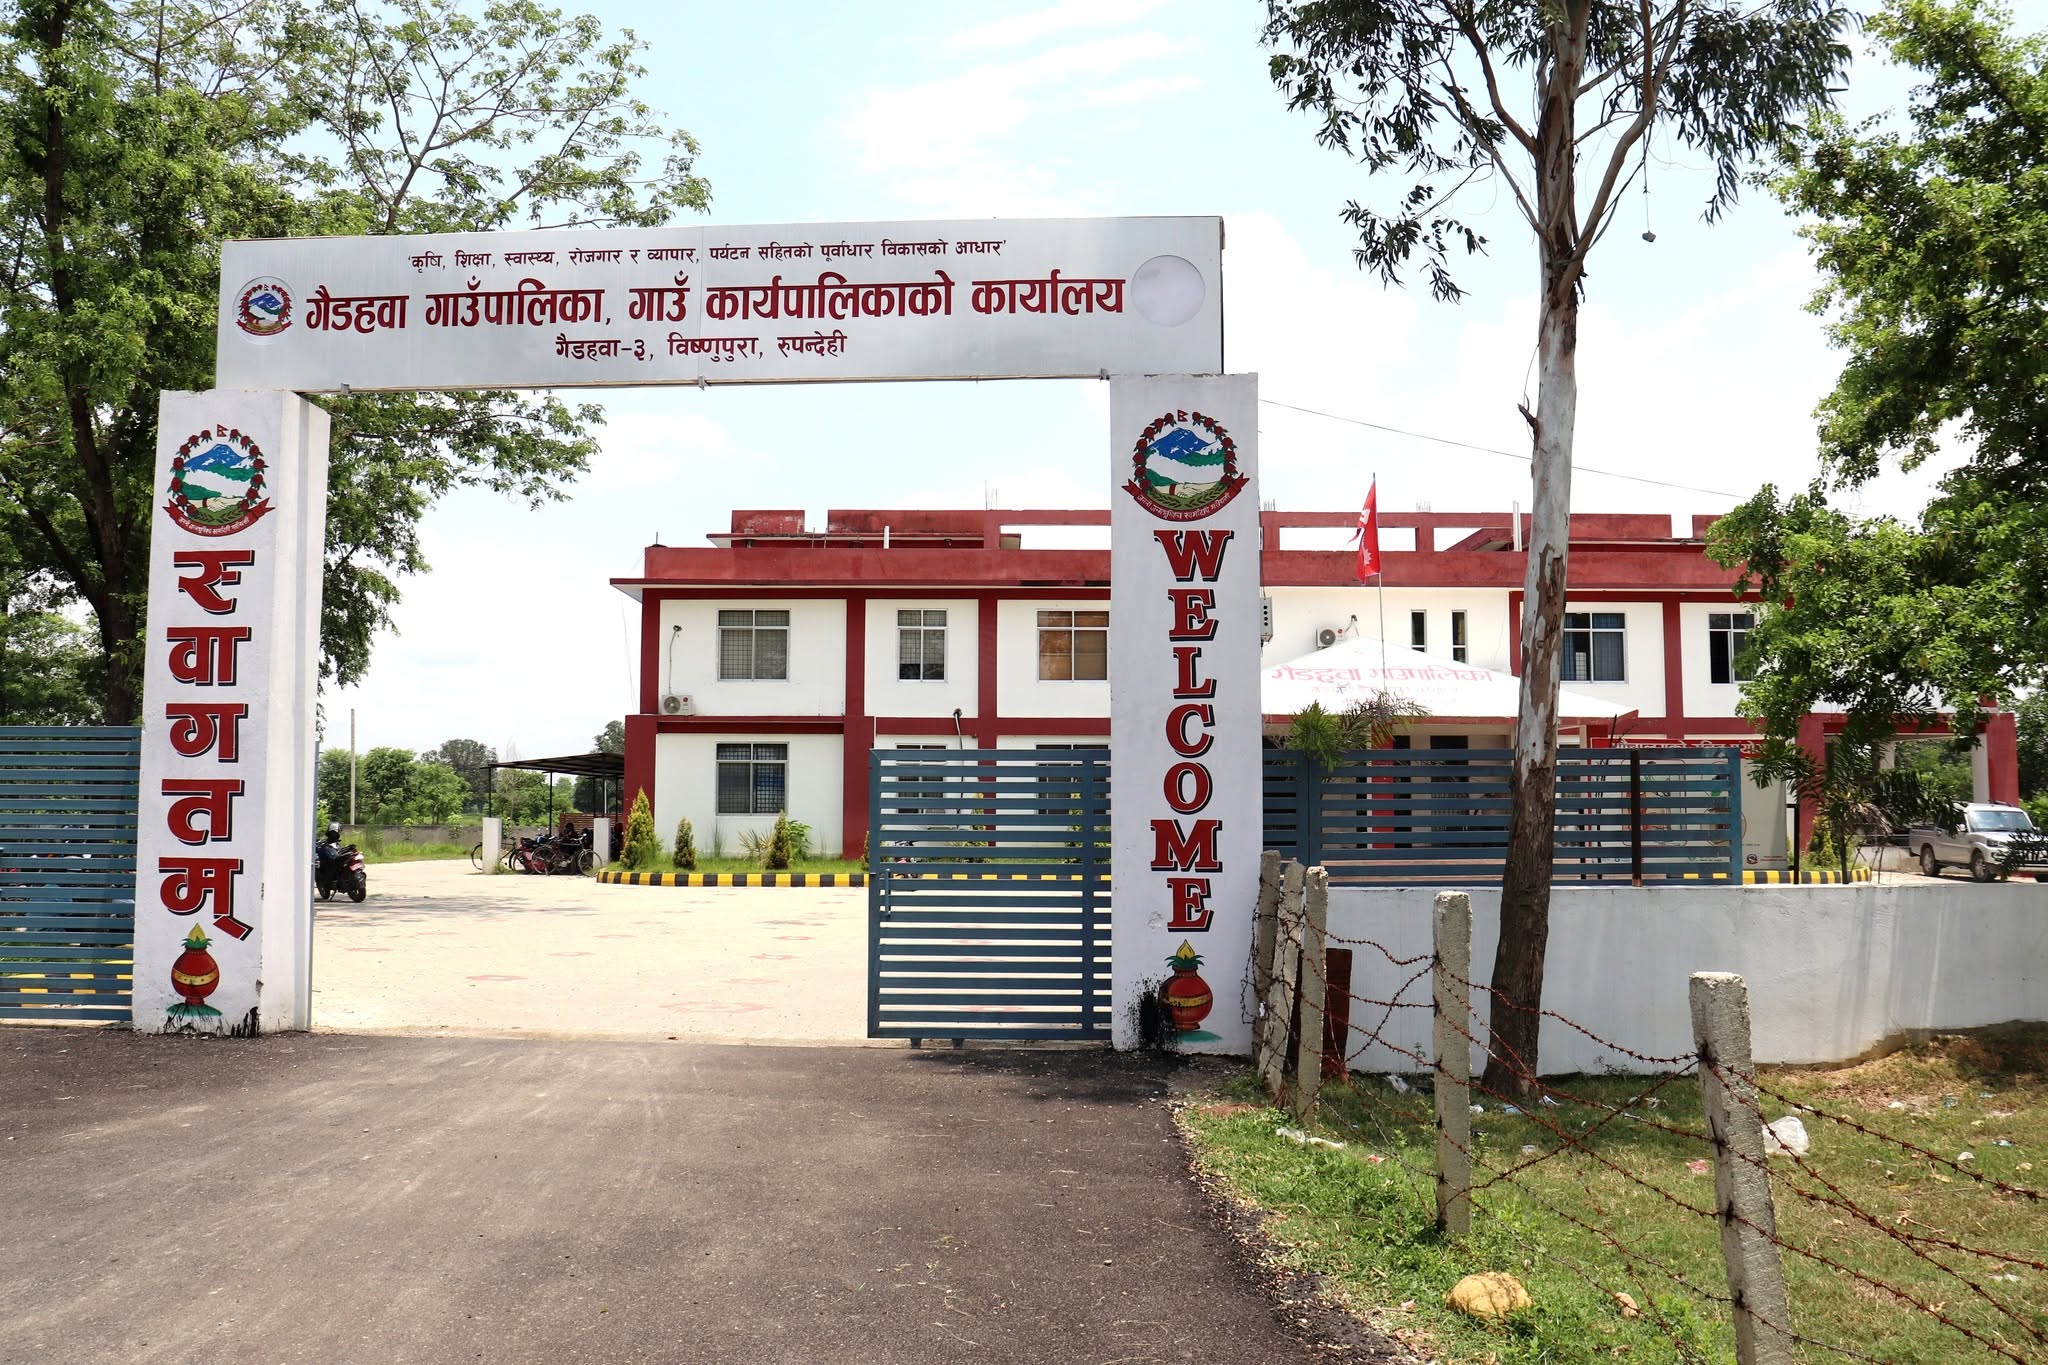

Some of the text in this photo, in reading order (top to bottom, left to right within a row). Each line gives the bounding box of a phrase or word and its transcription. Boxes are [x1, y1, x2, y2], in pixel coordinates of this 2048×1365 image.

[454, 249, 496, 269] शिक्षा,
[568, 247, 623, 266] रोजगार
[629, 249, 641, 264] र
[647, 248, 700, 264] व्यापार,
[709, 243, 750, 260] पर्यटन
[758, 241, 814, 262] सहितको
[820, 240, 874, 262] पूर्वाधार
[881, 238, 949, 257] विकासको
[306, 269, 1126, 334] गैडहवा गाउँपालिका, गाउँ कार्यपालिकाको कार्यालय
[667, 331, 763, 362] विष्णुपुरा,
[777, 329, 847, 358] रुपन्देही
[1150, 529, 1235, 933] WELCOME
